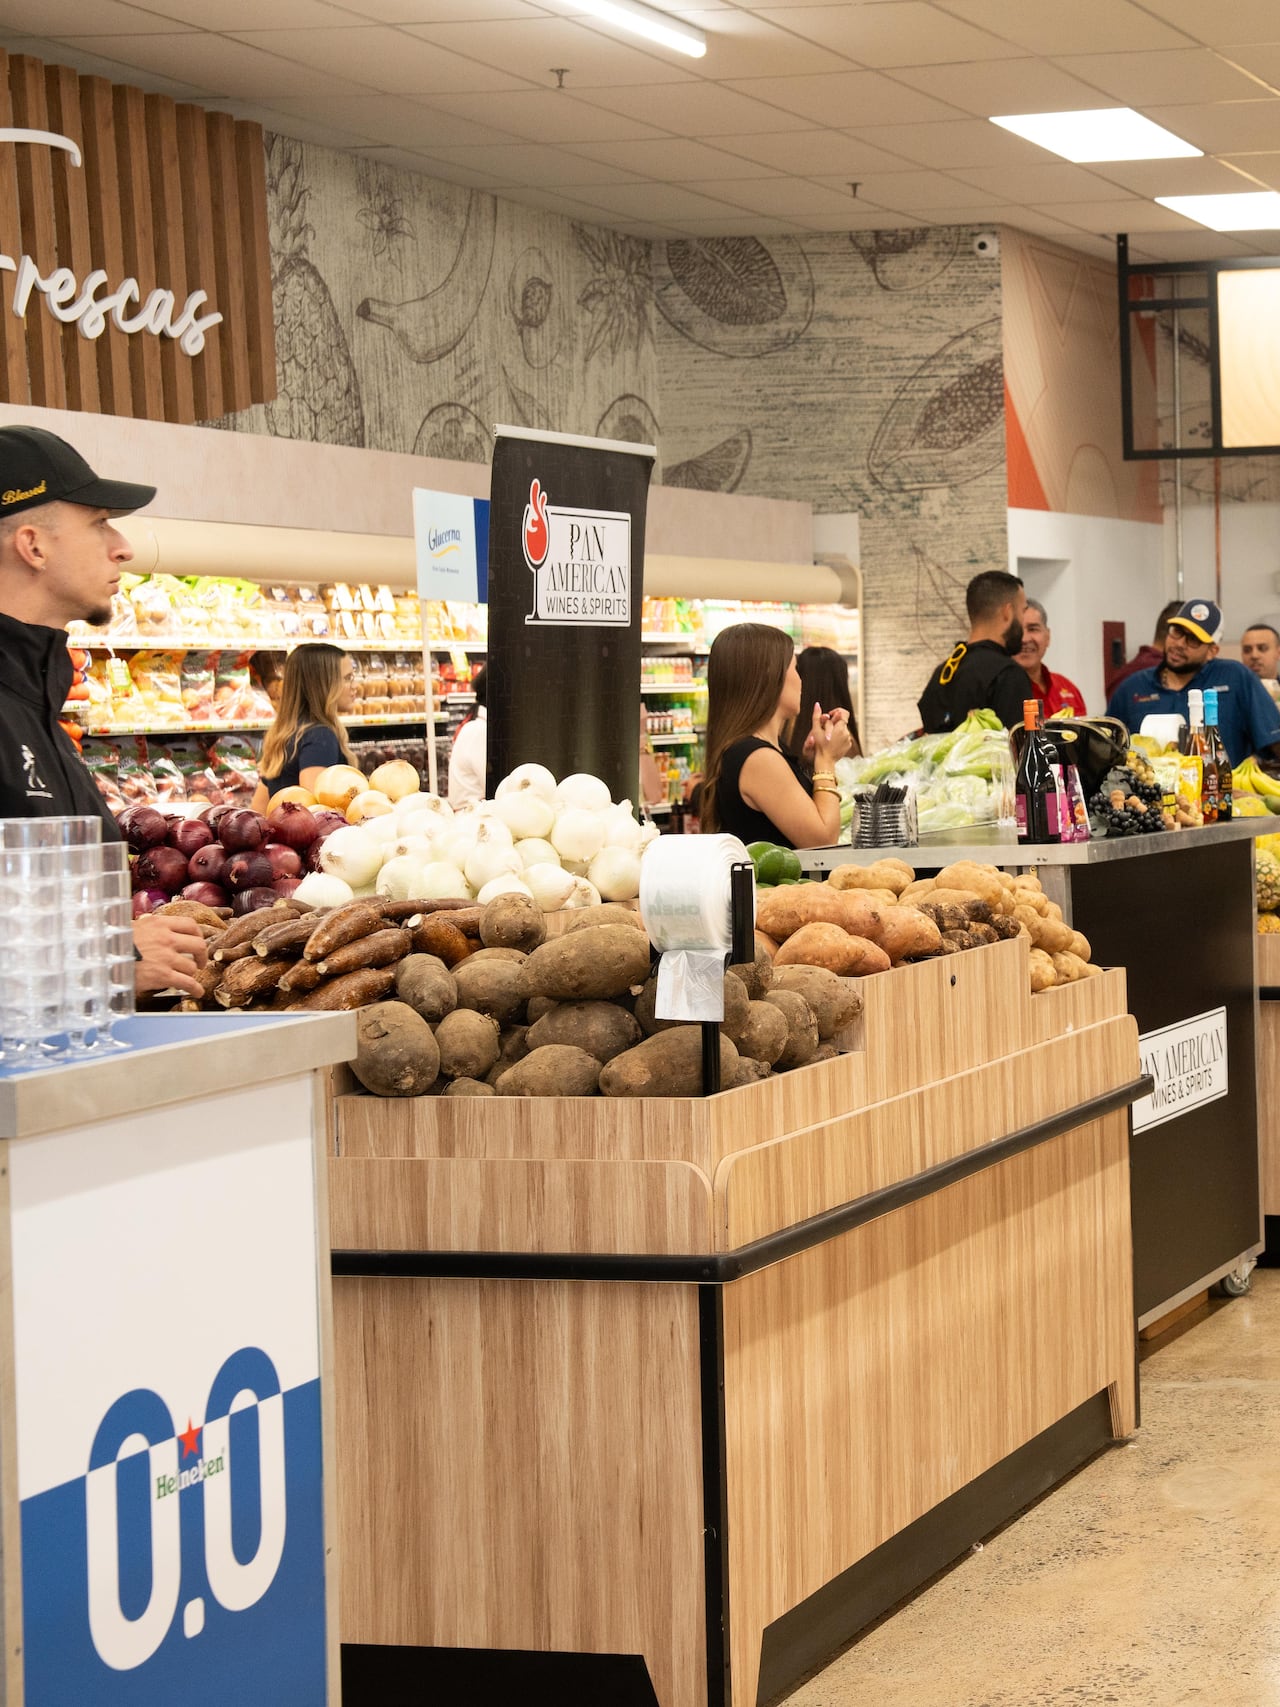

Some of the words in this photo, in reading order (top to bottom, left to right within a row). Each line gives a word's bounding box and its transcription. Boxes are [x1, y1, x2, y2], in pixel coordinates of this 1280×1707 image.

[0, 254, 223, 357] rescas
[428, 527, 461, 551] Glucerna
[569, 523, 606, 561] PAN
[547, 562, 627, 594] AMERICAN
[546, 597, 579, 614] WINES
[581, 598, 588, 615] &
[590, 599, 627, 615] SPIRITS
[1164, 1026, 1224, 1082] AMERICAN
[1151, 1081, 1176, 1110] WINES
[1178, 1080, 1184, 1099] &
[1186, 1068, 1212, 1096] SPIRITS
[157, 1456, 224, 1499] Heineken
[86, 1346, 287, 1671] 0.0
